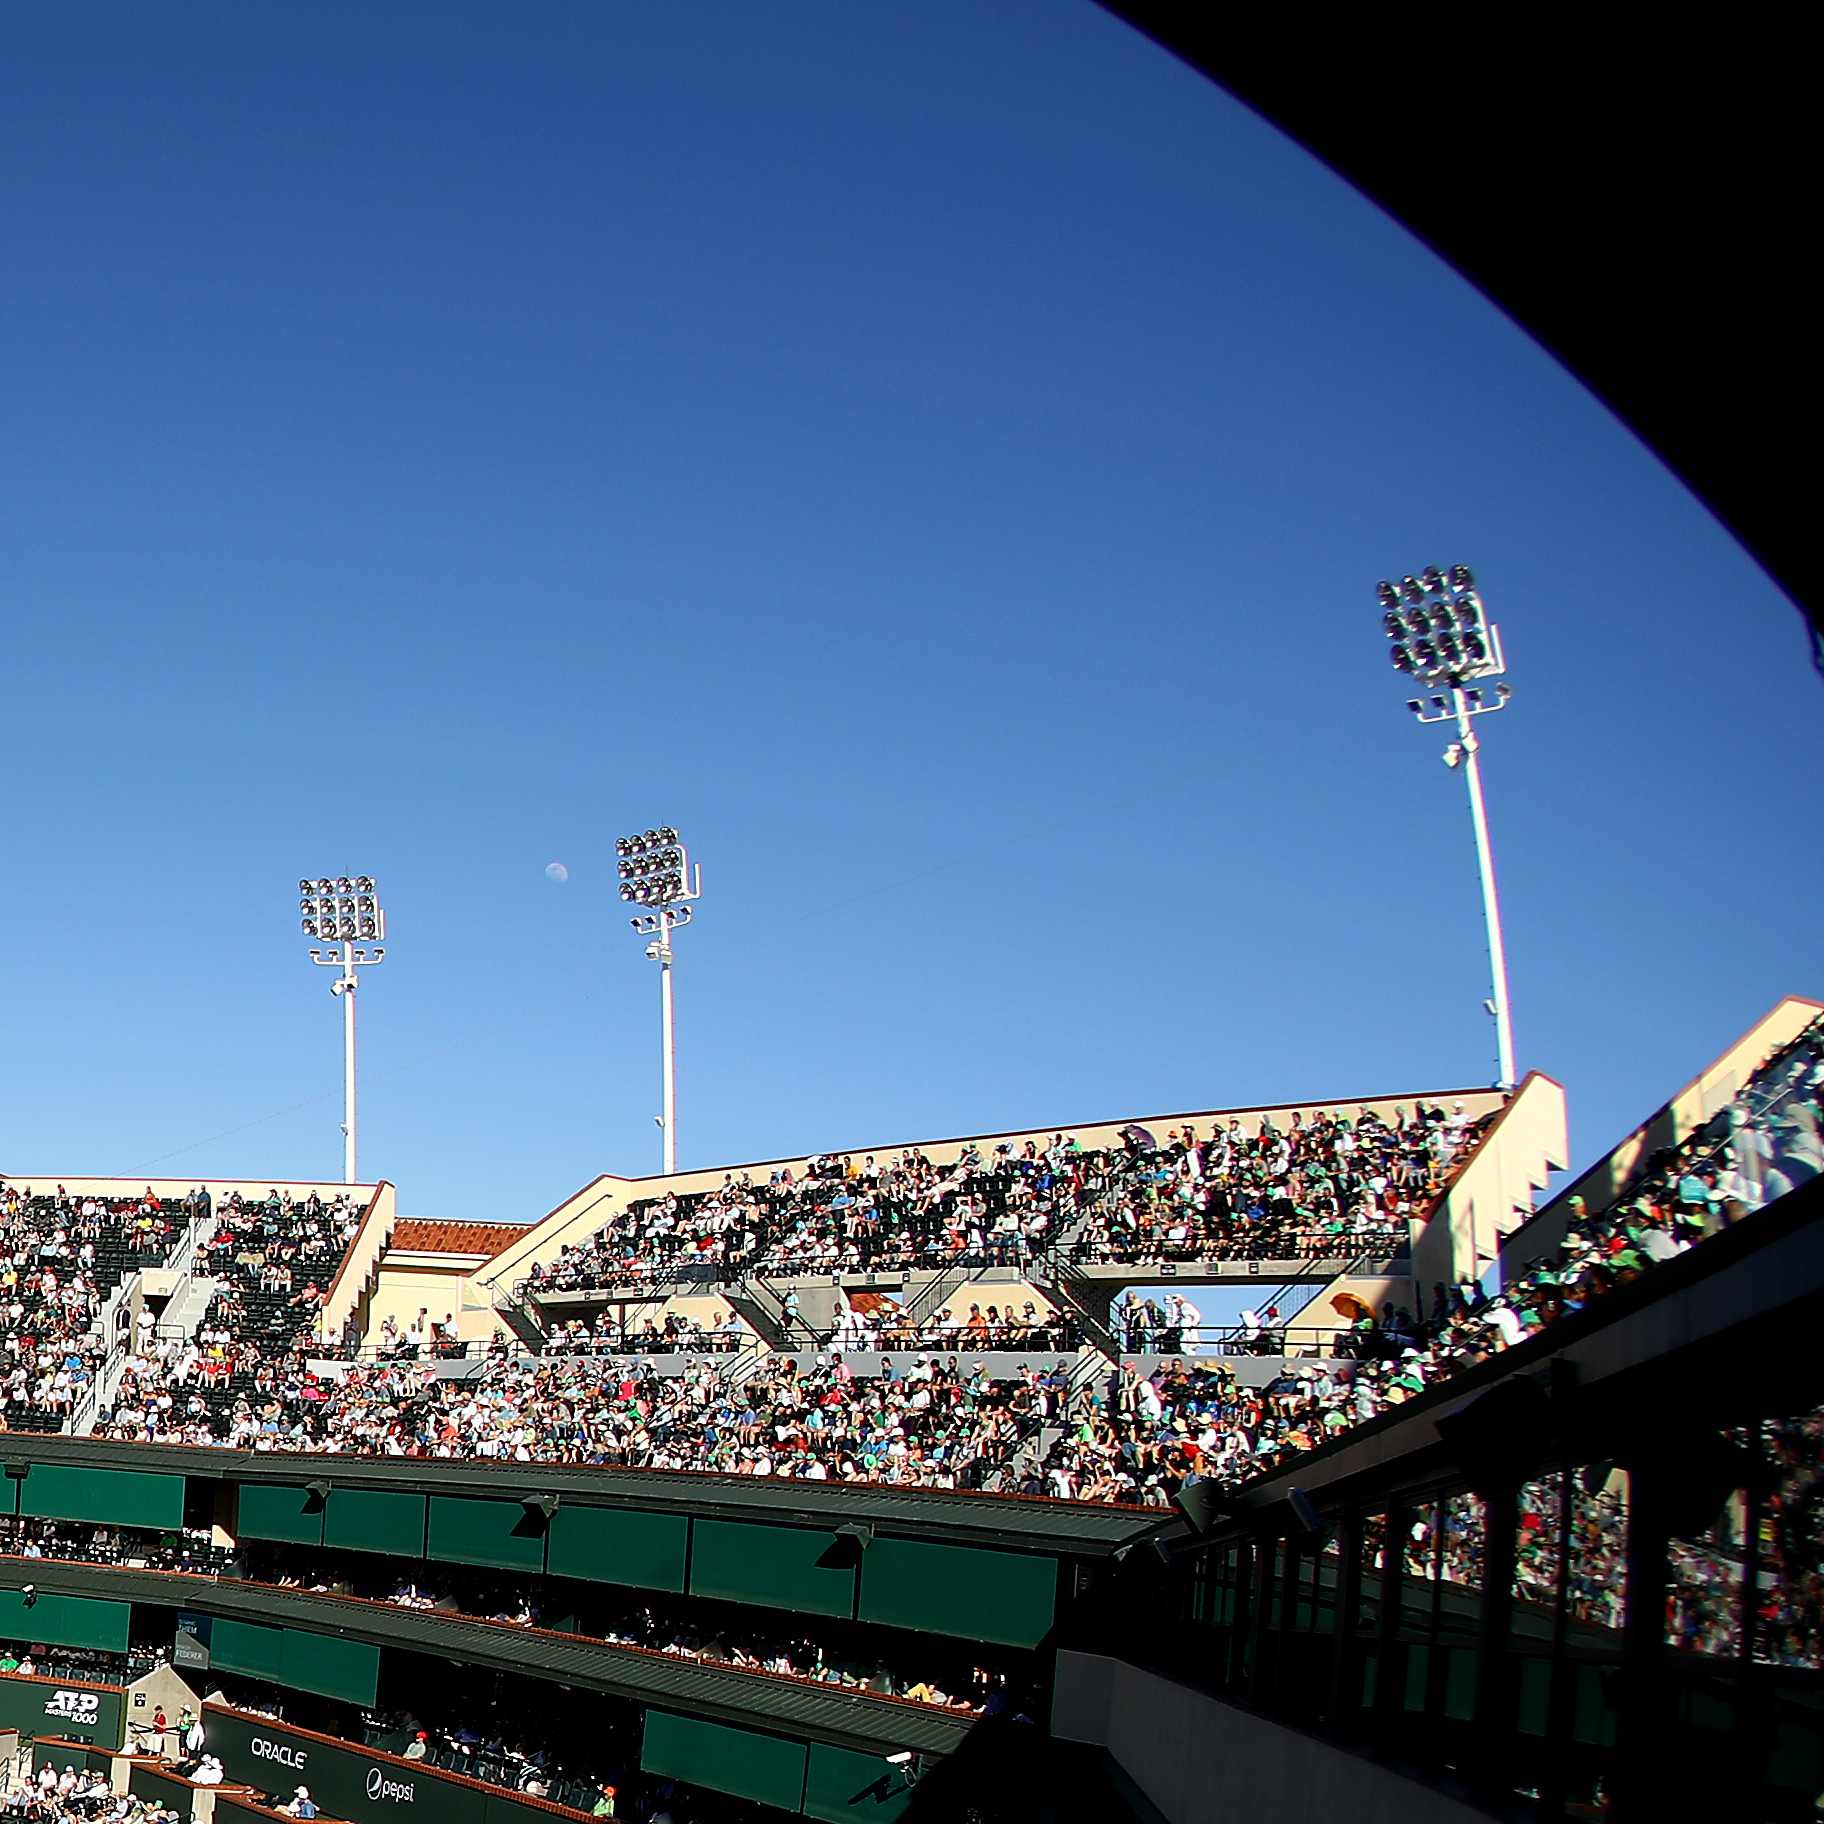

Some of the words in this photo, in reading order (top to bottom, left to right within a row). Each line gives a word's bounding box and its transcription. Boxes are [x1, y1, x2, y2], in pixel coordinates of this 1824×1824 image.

[45, 1690, 99, 1712] ATP
[71, 1712, 99, 1725] 1000
[251, 1738, 308, 1770] ORACLE
[381, 1780, 415, 1802] pepsi
